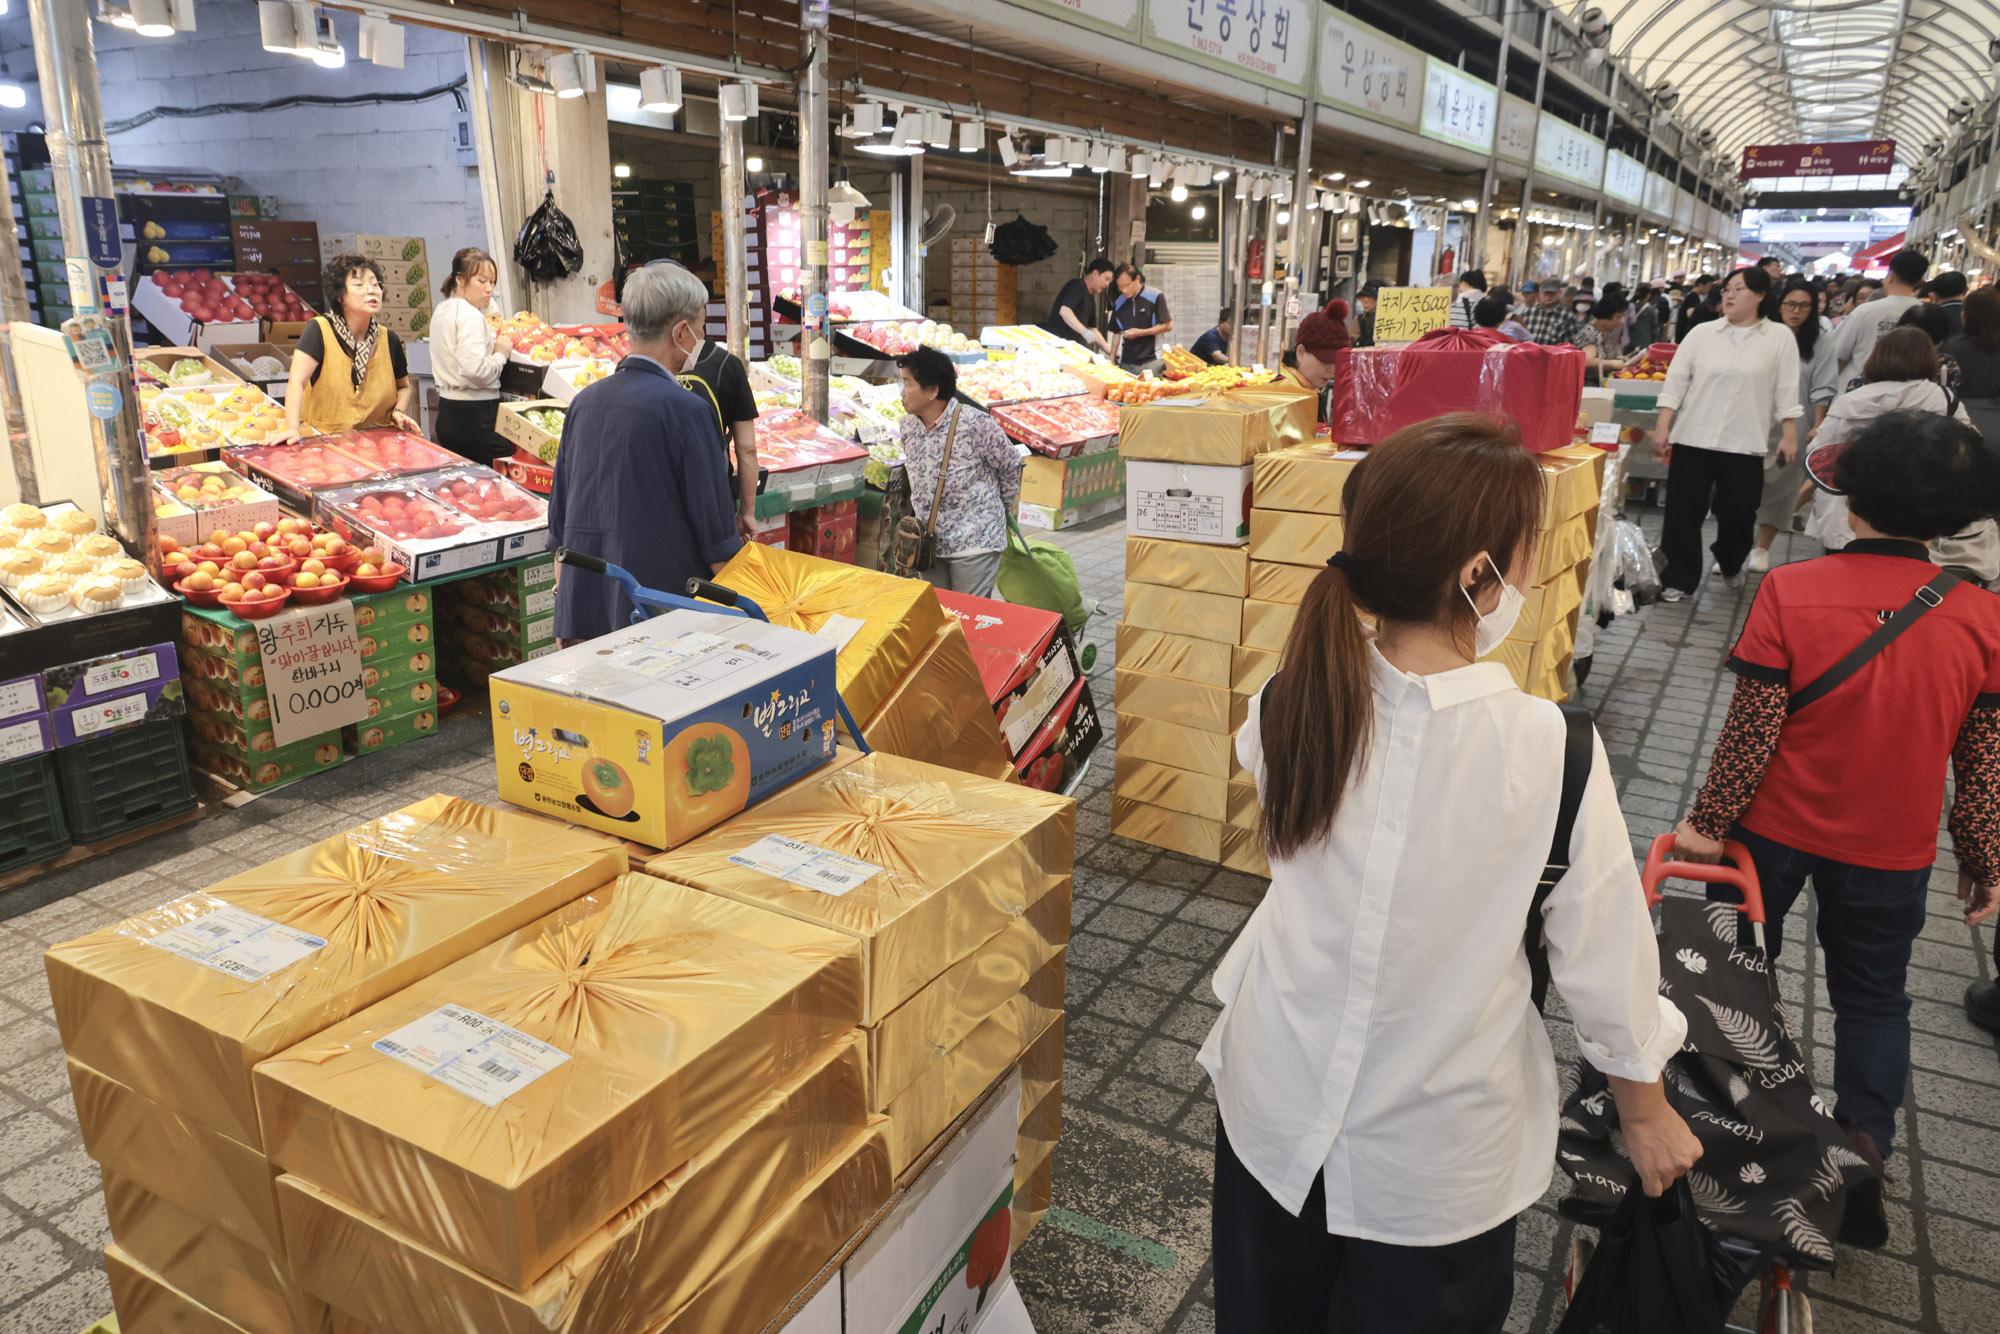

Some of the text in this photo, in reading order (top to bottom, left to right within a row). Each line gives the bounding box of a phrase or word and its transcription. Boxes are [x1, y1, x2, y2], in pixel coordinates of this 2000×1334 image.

[1341, 40, 1408, 108] 우성상회
[1375, 317, 1406, 339] 꼴뚜기
[259, 612, 348, 656] 왕 추희 자두
[124, 704, 142, 716] 포도
[753, 689, 811, 739] 별그리고
[513, 727, 572, 765] 별그리고
[780, 723, 791, 740] 단감
[519, 765, 534, 782] 단감
[1692, 1111, 1764, 1145] Happy
